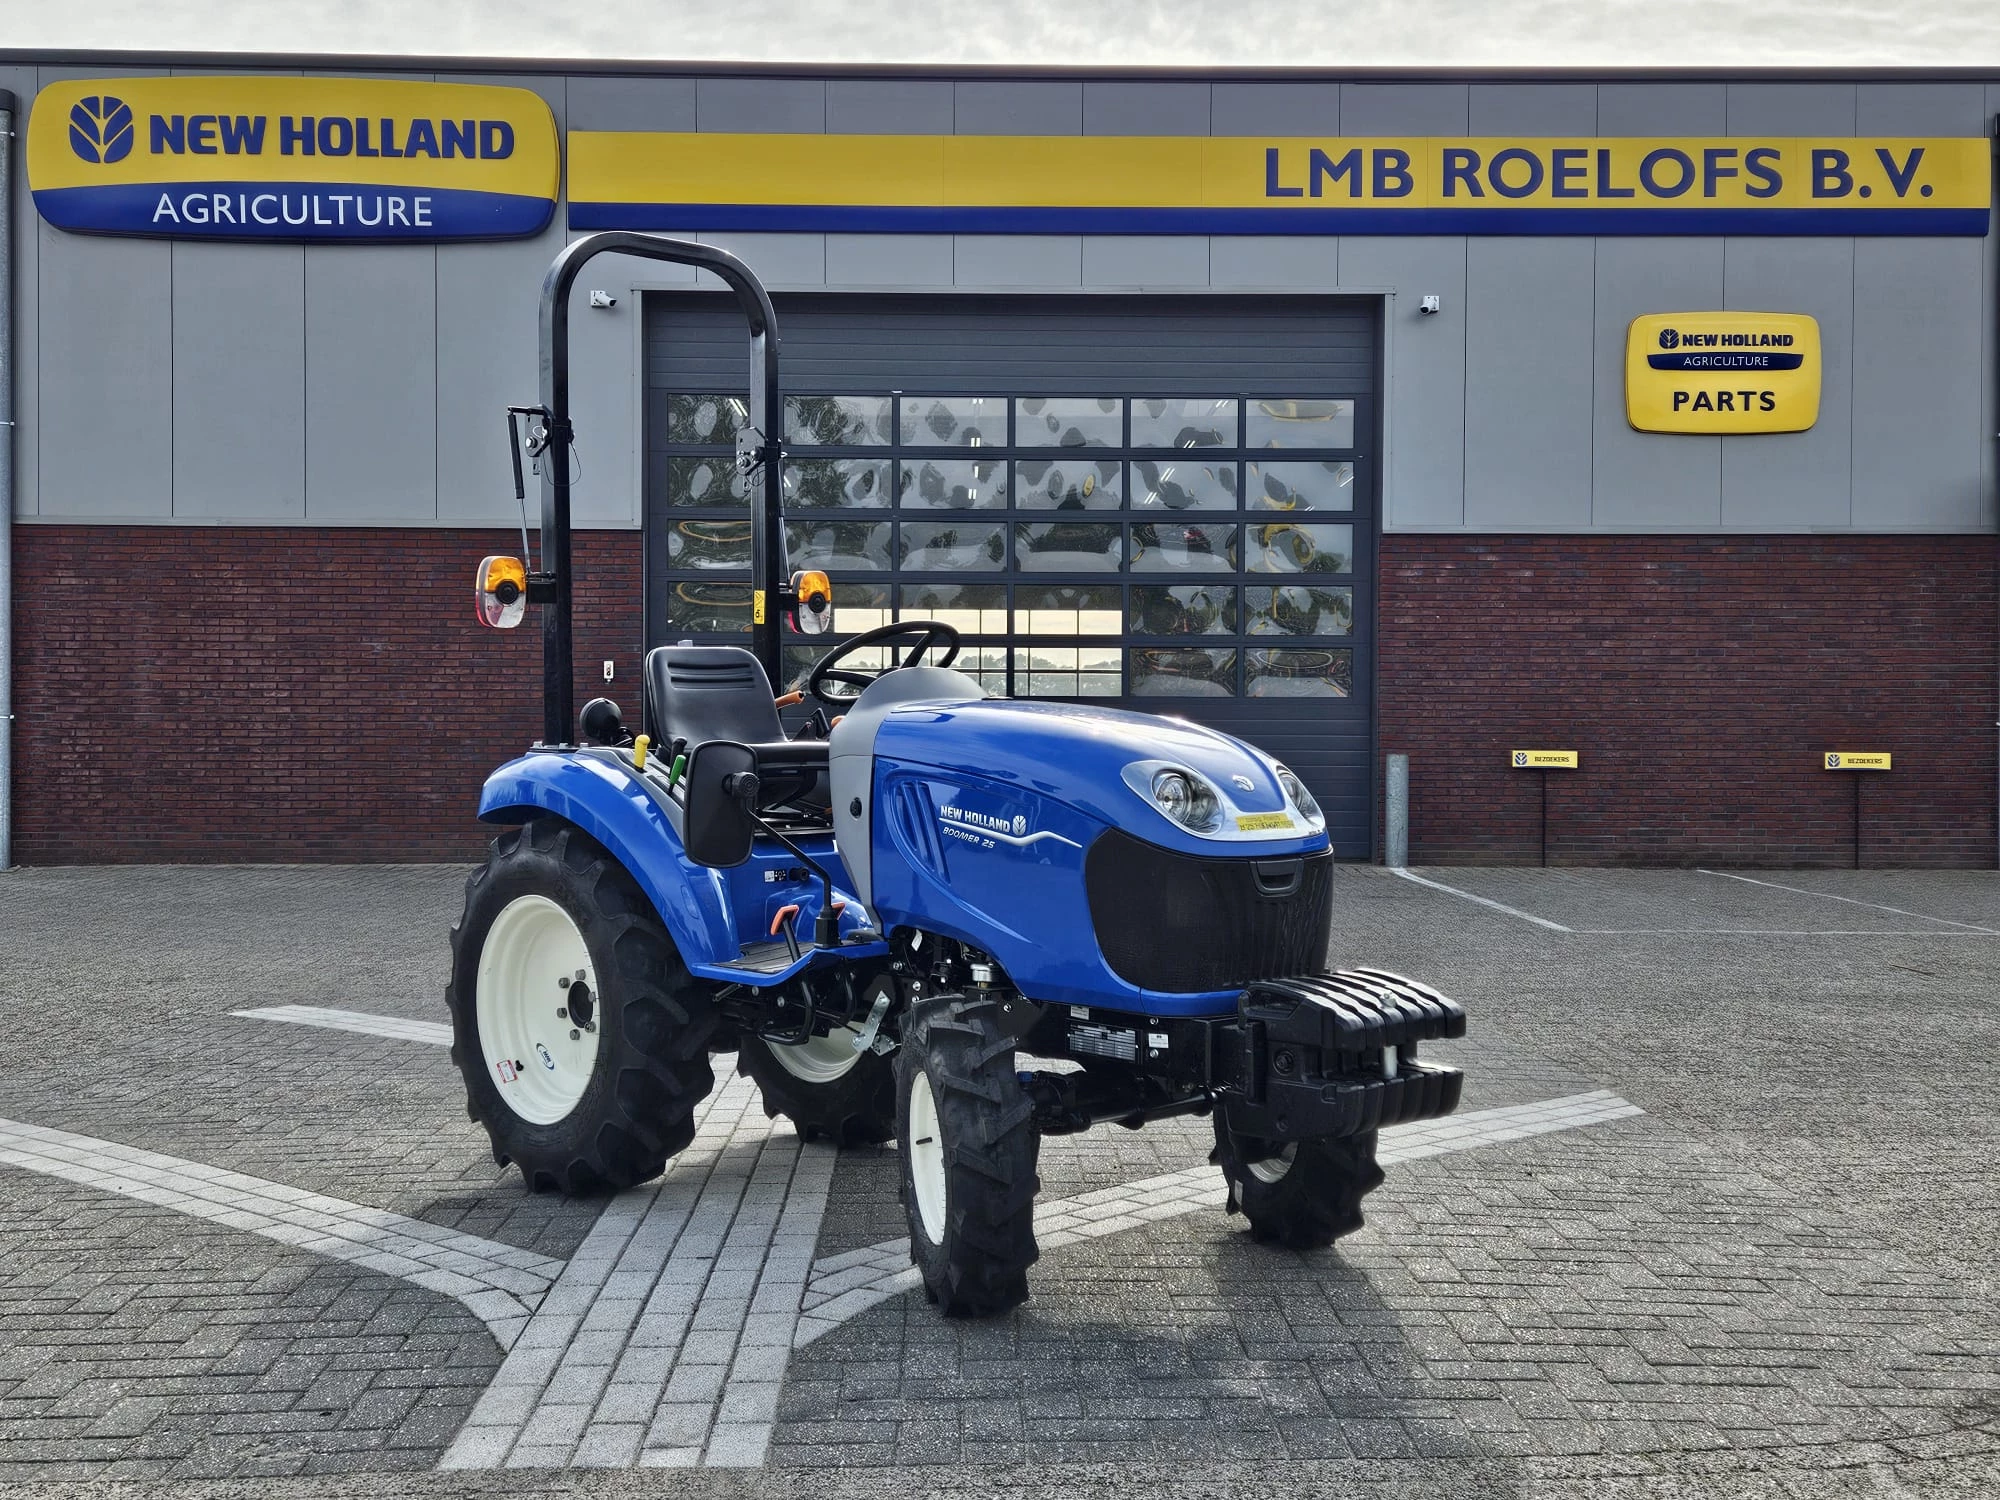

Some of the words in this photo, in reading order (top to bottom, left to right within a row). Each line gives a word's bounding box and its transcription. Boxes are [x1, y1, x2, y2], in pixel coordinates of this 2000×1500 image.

[150, 114, 267, 155] NEW
[279, 115, 515, 160] HOLLAND
[1265, 147, 1414, 198] LMB
[1442, 147, 1783, 198] ROELOFS
[1811, 147, 1934, 198] B.V.
[152, 192, 433, 227] AGRICULTURE
[1682, 334, 1718, 346] NEW
[1721, 334, 1794, 346] HOLLAND
[1683, 356, 1769, 366] AGRICULTURE
[1673, 391, 1776, 412] PARTS
[940, 805, 963, 820] NEW
[964, 810, 1011, 833] HOLLAND
[942, 826, 980, 844] BOOMER
[981, 839, 996, 849] 25
